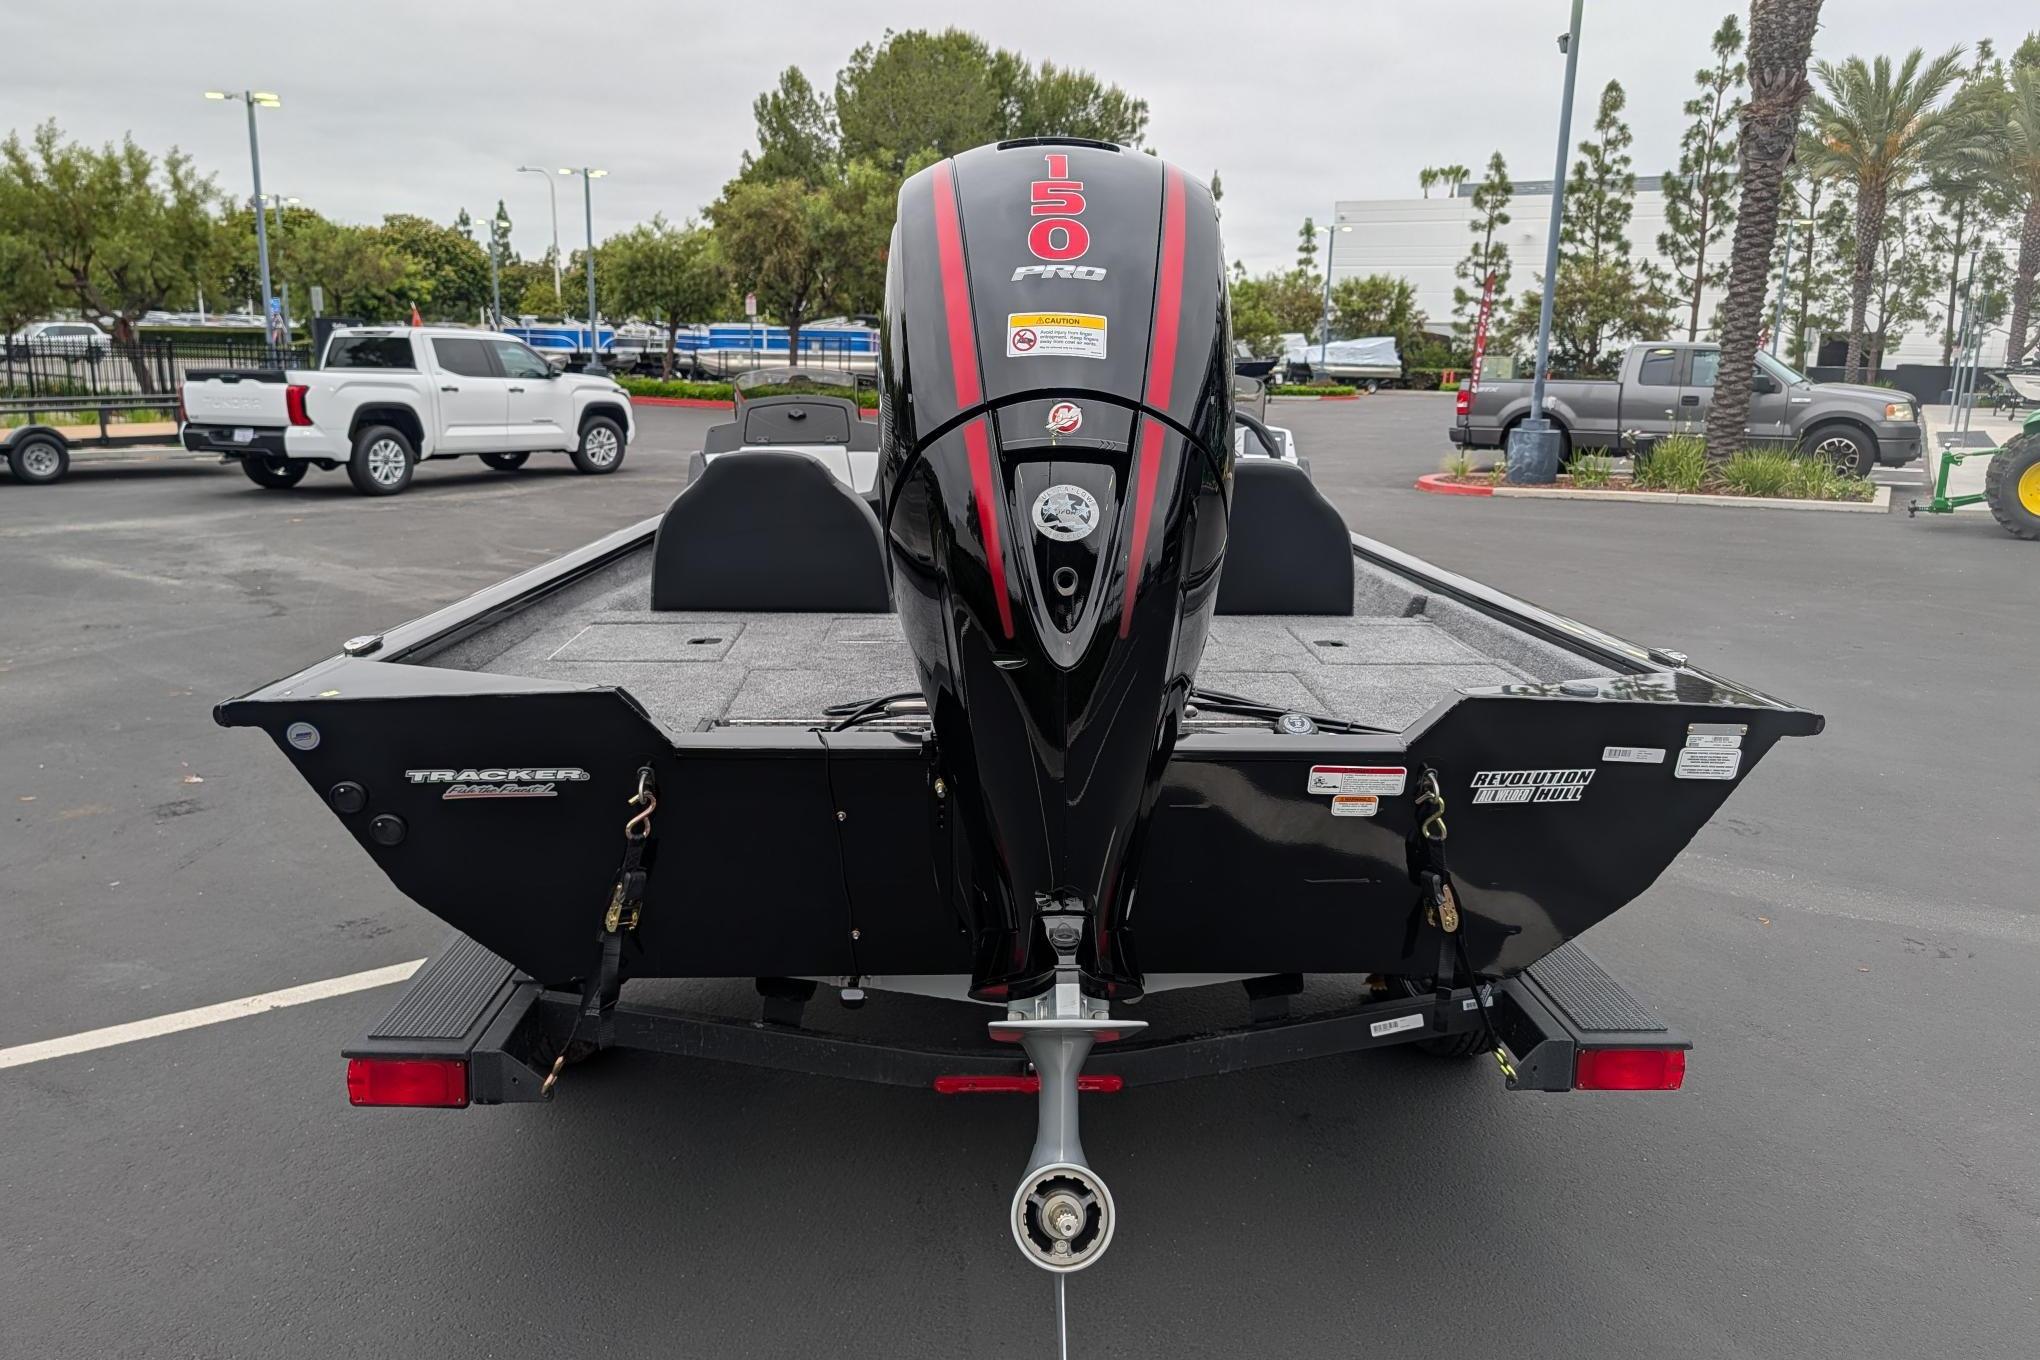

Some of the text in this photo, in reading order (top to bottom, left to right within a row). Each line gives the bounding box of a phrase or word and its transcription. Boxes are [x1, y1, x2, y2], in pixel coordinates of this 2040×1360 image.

[1028, 154, 1090, 261] 150
[1011, 264, 1107, 281] PRO
[1044, 317, 1080, 325] CAUTION
[201, 395, 262, 409] TUNDRA
[406, 769, 584, 783] TRACKER
[1472, 770, 1596, 787] REVOLUTION
[1534, 786, 1583, 802] HULL
